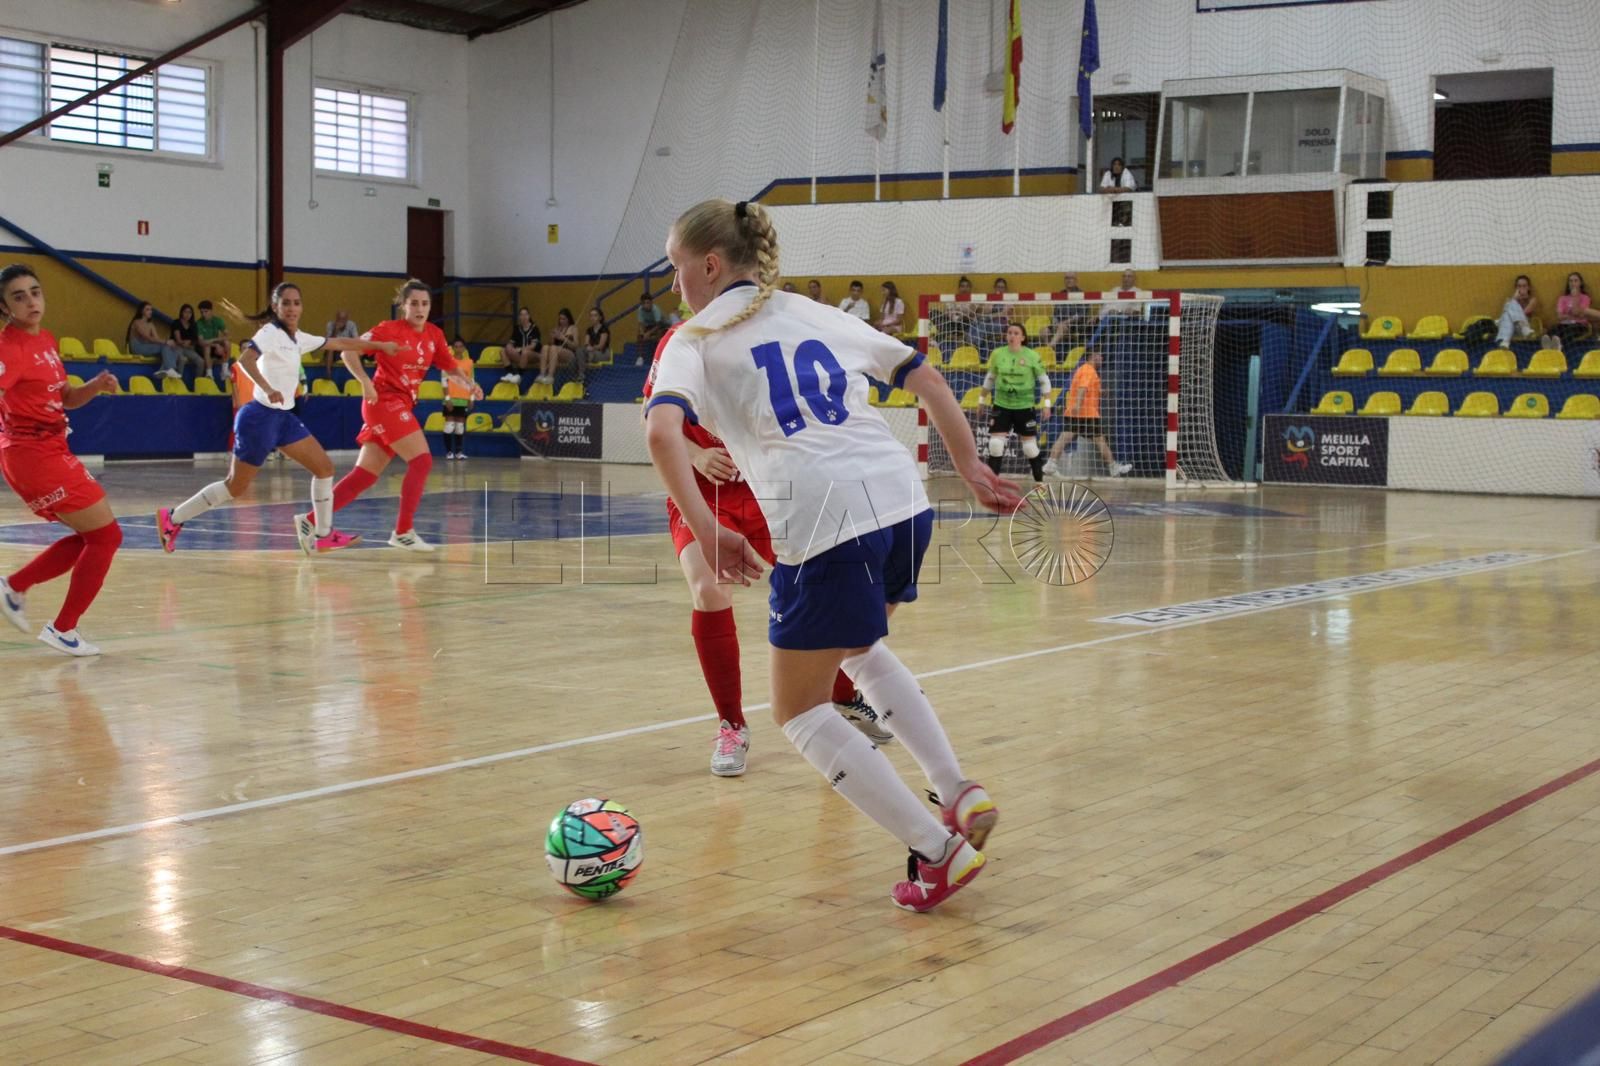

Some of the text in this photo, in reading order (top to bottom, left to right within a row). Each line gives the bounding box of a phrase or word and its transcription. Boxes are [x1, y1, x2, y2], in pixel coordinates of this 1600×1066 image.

[1304, 128, 1331, 136] SOLO
[1298, 138, 1337, 147] PRENSA
[750, 339, 850, 437] 10
[558, 416, 591, 426] MELILLA
[558, 426, 585, 435] SPORT
[557, 435, 591, 444] CAPITAL
[1321, 434, 1370, 445] MELILLA
[1321, 445, 1361, 456] SPORT
[1320, 456, 1370, 467] CAPITAL
